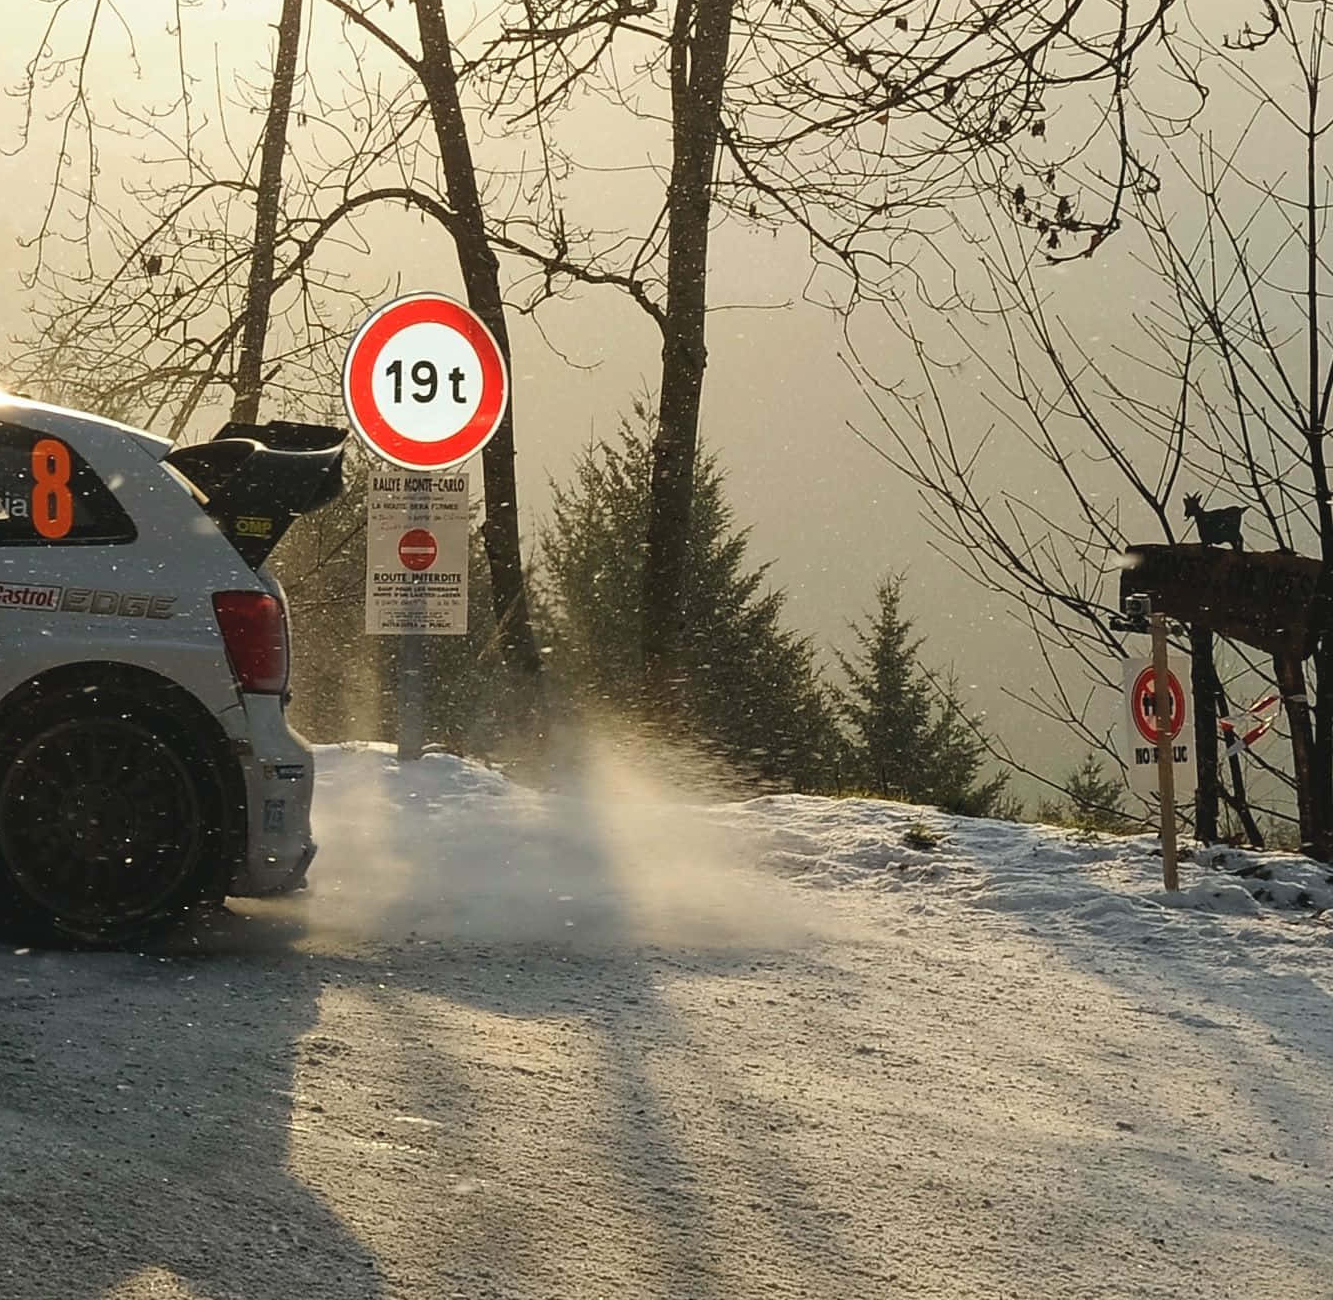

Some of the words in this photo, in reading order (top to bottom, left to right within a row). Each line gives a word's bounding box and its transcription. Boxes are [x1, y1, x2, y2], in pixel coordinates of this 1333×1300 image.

[386, 360, 438, 404] 19
[448, 366, 467, 404] t
[31, 438, 74, 539] 8
[373, 478, 400, 492] RALLYE
[404, 478, 465, 493] MONTE-CARLO
[236, 520, 271, 533] OMP
[374, 573, 406, 582] ROUTE
[412, 573, 462, 582] INTERDITE
[59, 587, 178, 620] EDGE
[1136, 747, 1150, 765] NO
